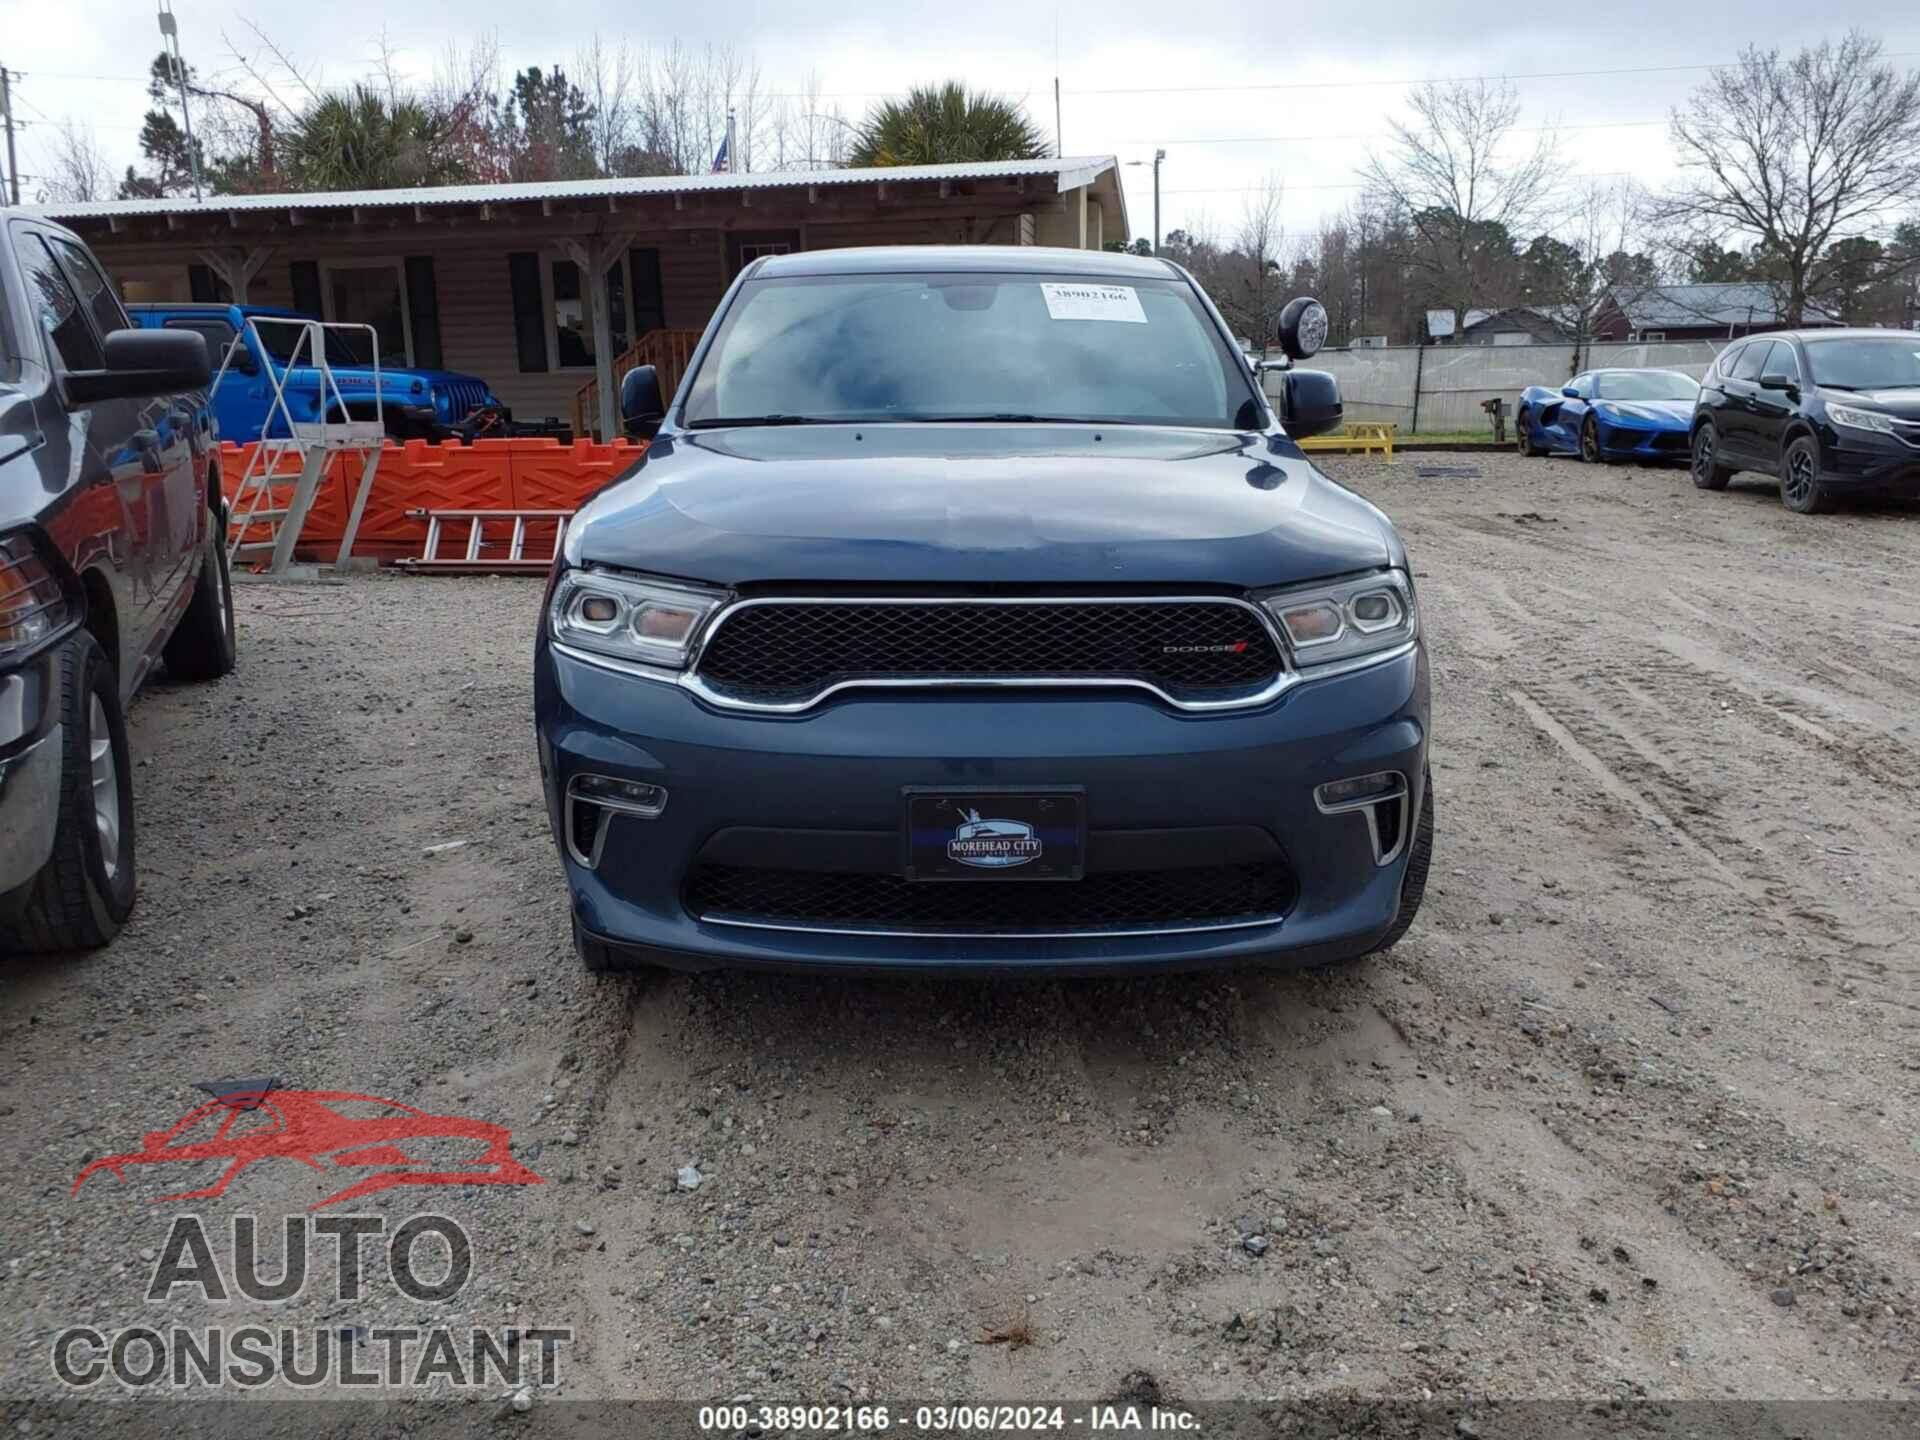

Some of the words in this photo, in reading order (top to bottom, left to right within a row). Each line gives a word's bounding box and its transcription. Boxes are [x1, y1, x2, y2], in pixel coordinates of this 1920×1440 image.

[1163, 645, 1234, 653] DODGE
[952, 841, 1010, 851] MOREHEAD
[1013, 841, 1039, 850] CITY
